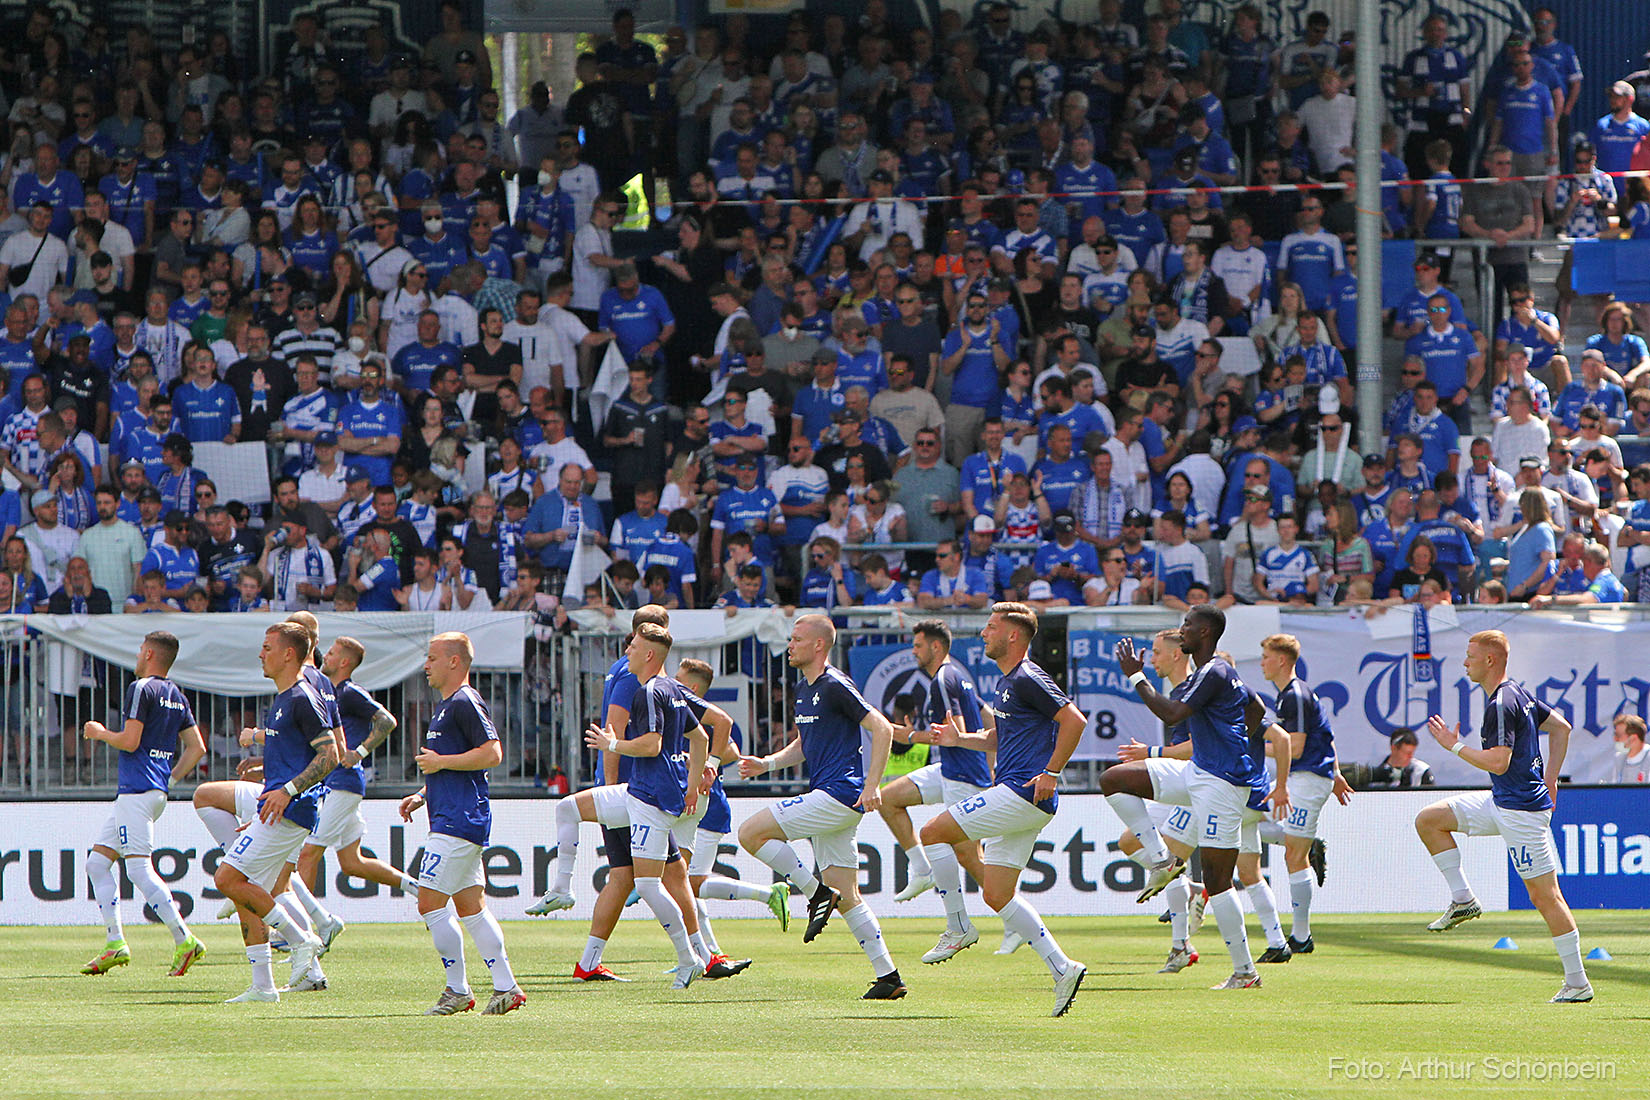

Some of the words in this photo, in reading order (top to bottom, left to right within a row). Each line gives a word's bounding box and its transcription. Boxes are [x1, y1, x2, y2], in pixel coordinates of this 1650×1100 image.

[1168, 806, 1192, 831] 20
[1206, 814, 1218, 836] 5
[1288, 807, 1308, 827] 38
[118, 825, 128, 845] 9
[234, 835, 254, 856] 9
